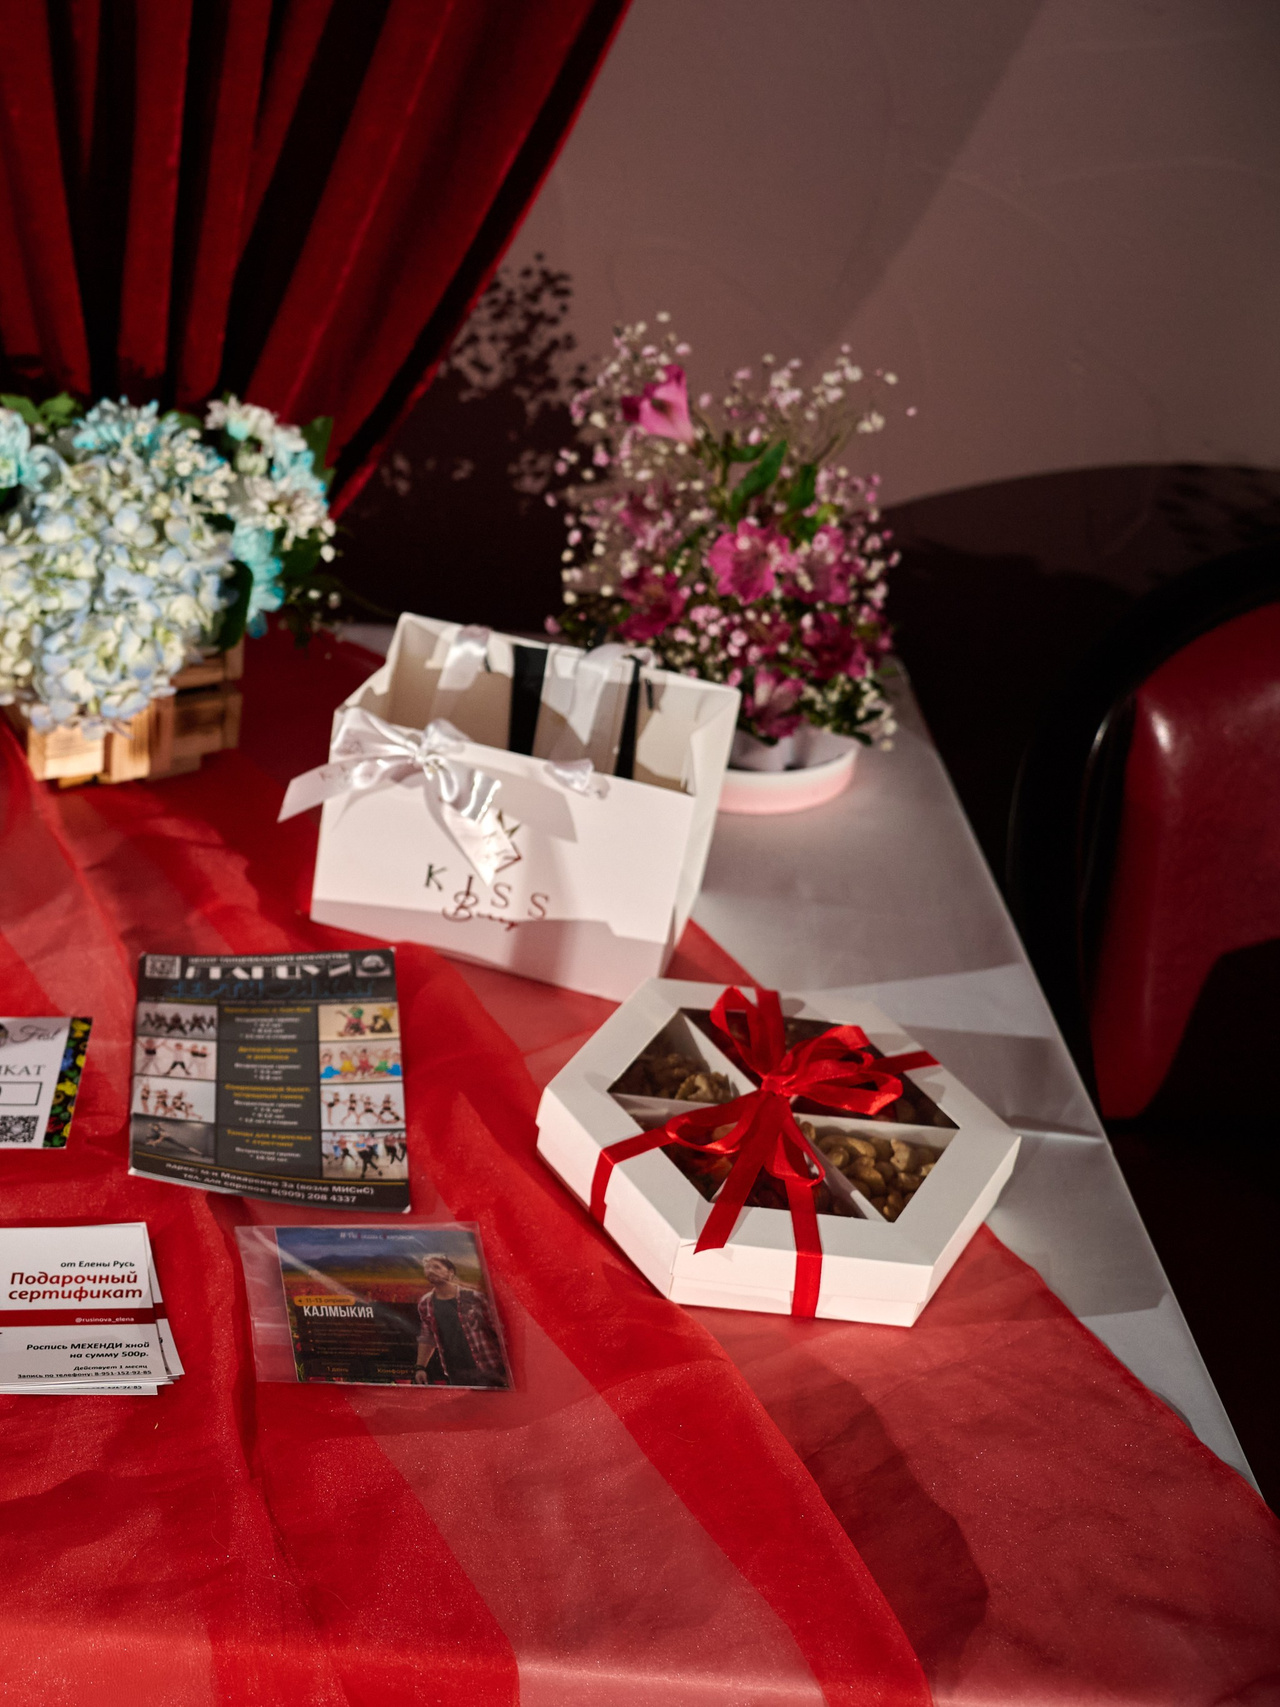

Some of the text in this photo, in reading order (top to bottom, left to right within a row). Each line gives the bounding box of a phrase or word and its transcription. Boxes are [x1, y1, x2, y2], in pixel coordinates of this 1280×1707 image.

[78, 1260, 111, 1268] Елены
[113, 1260, 135, 1269] Русь
[10, 1270, 138, 1288] Подарочный
[8, 1286, 143, 1303] сертификат
[303, 1305, 374, 1318] КАЛМЫКИЯ
[26, 1341, 150, 1351] Роспись МЕХЕНДИ хной
[85, 1352, 119, 1360] сумму
[122, 1350, 149, 1359] 500р.
